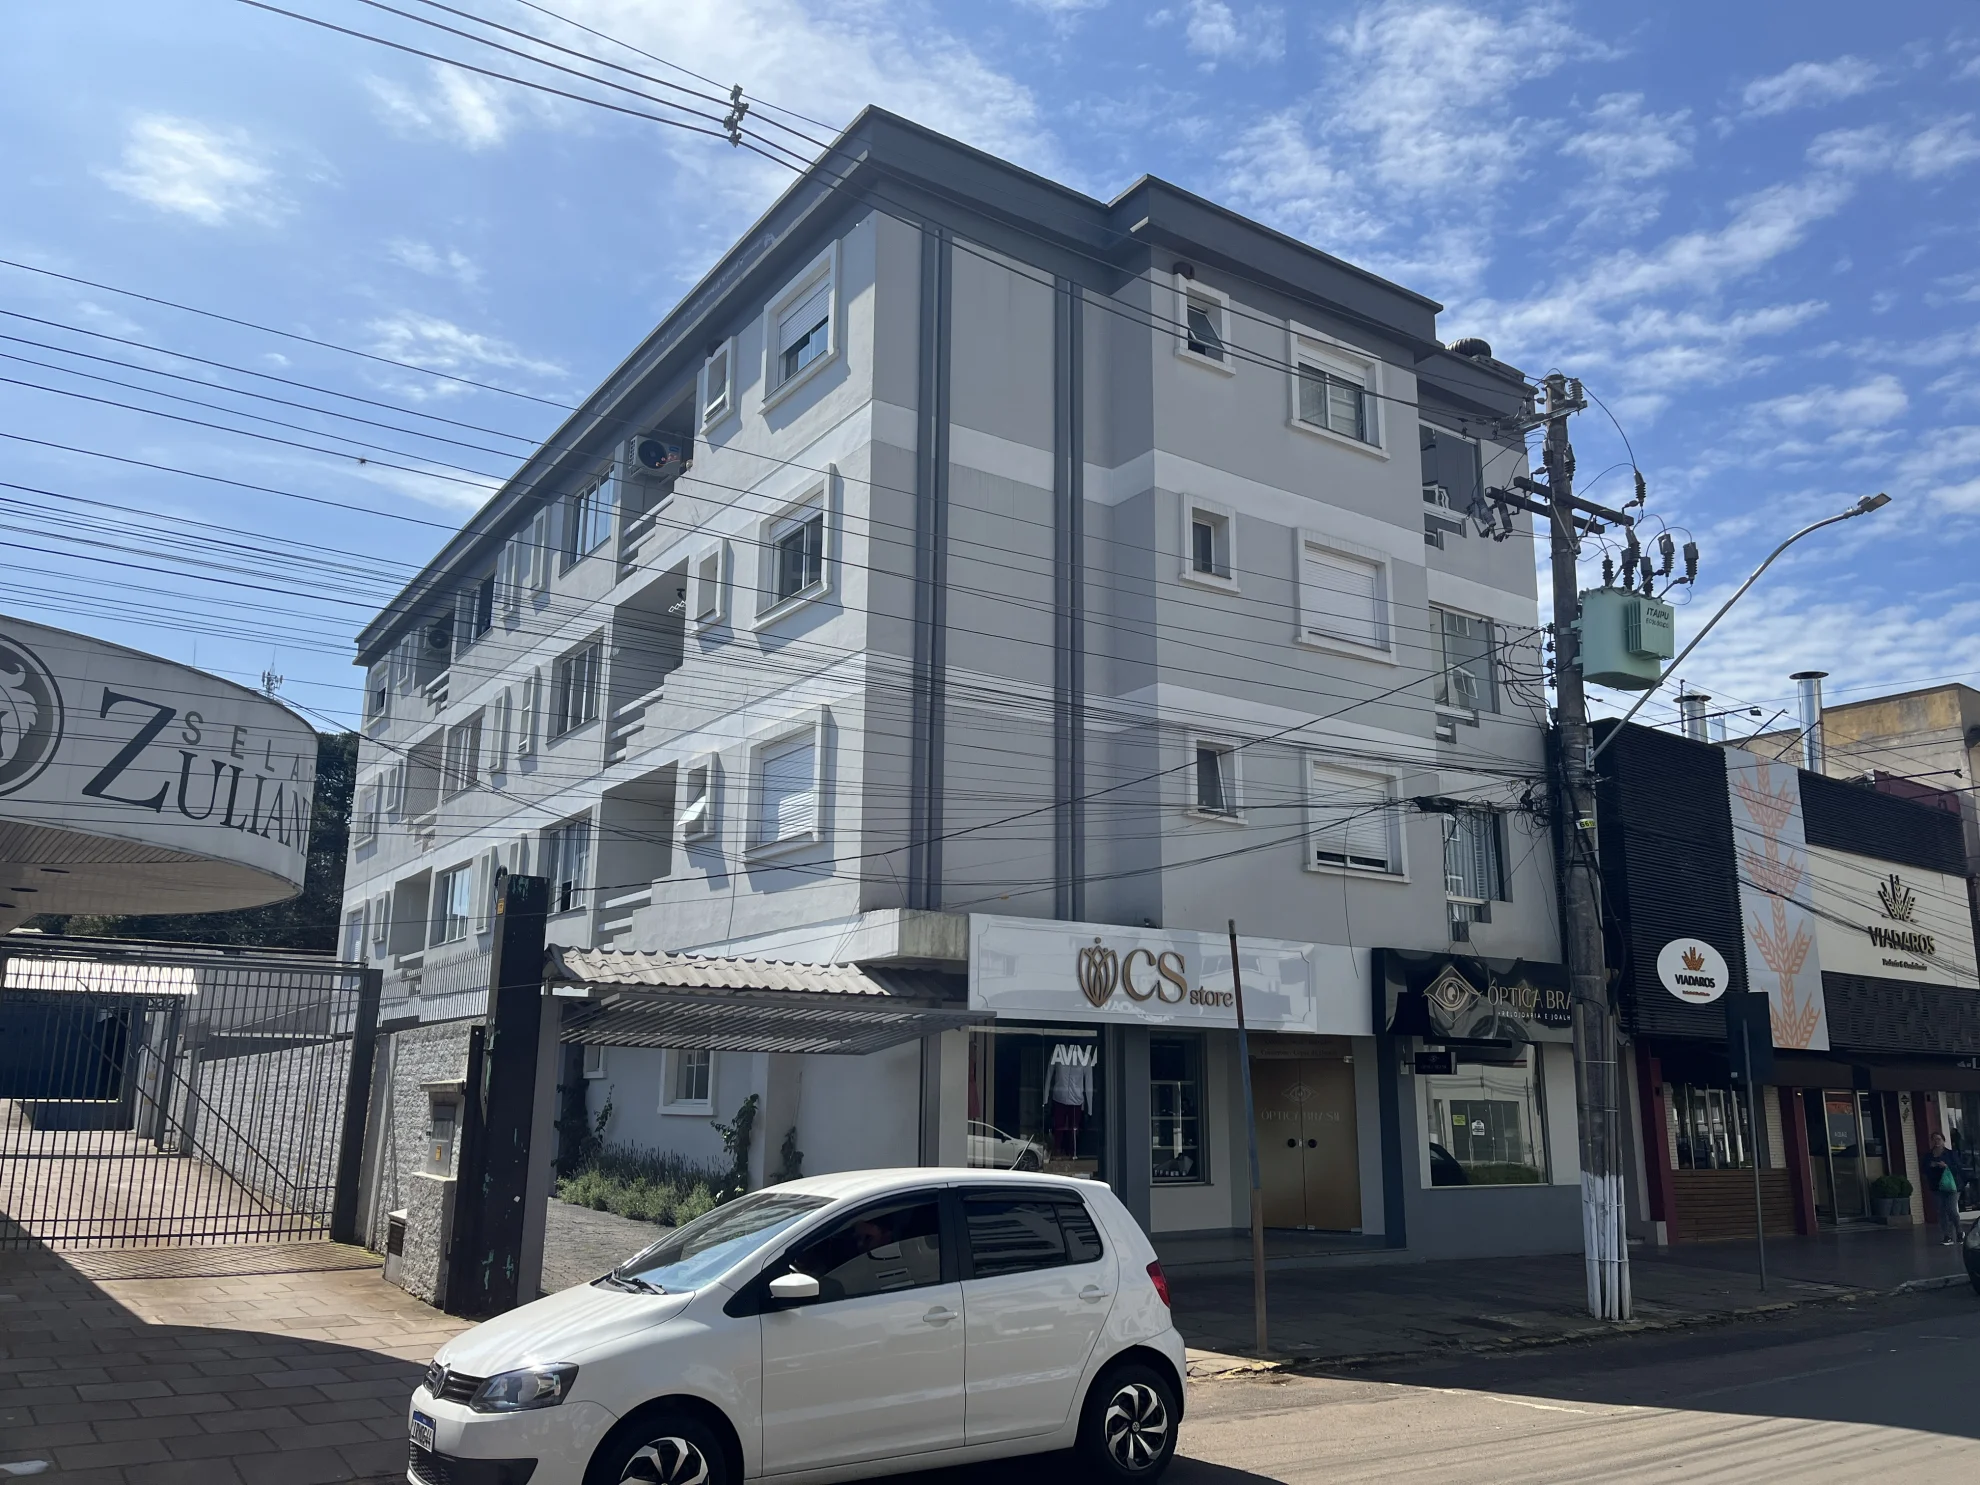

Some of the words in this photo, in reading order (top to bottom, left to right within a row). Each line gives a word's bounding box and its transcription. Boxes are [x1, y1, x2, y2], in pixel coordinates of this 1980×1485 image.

[1646, 607, 1669, 620] ITAIPU
[1867, 925, 1937, 955] VIADAROS
[1122, 948, 1188, 1004] CS
[1190, 985, 1234, 1007] store
[1674, 973, 1716, 988] VIADAROS
[1487, 979, 1543, 1009] ÓPTICA
